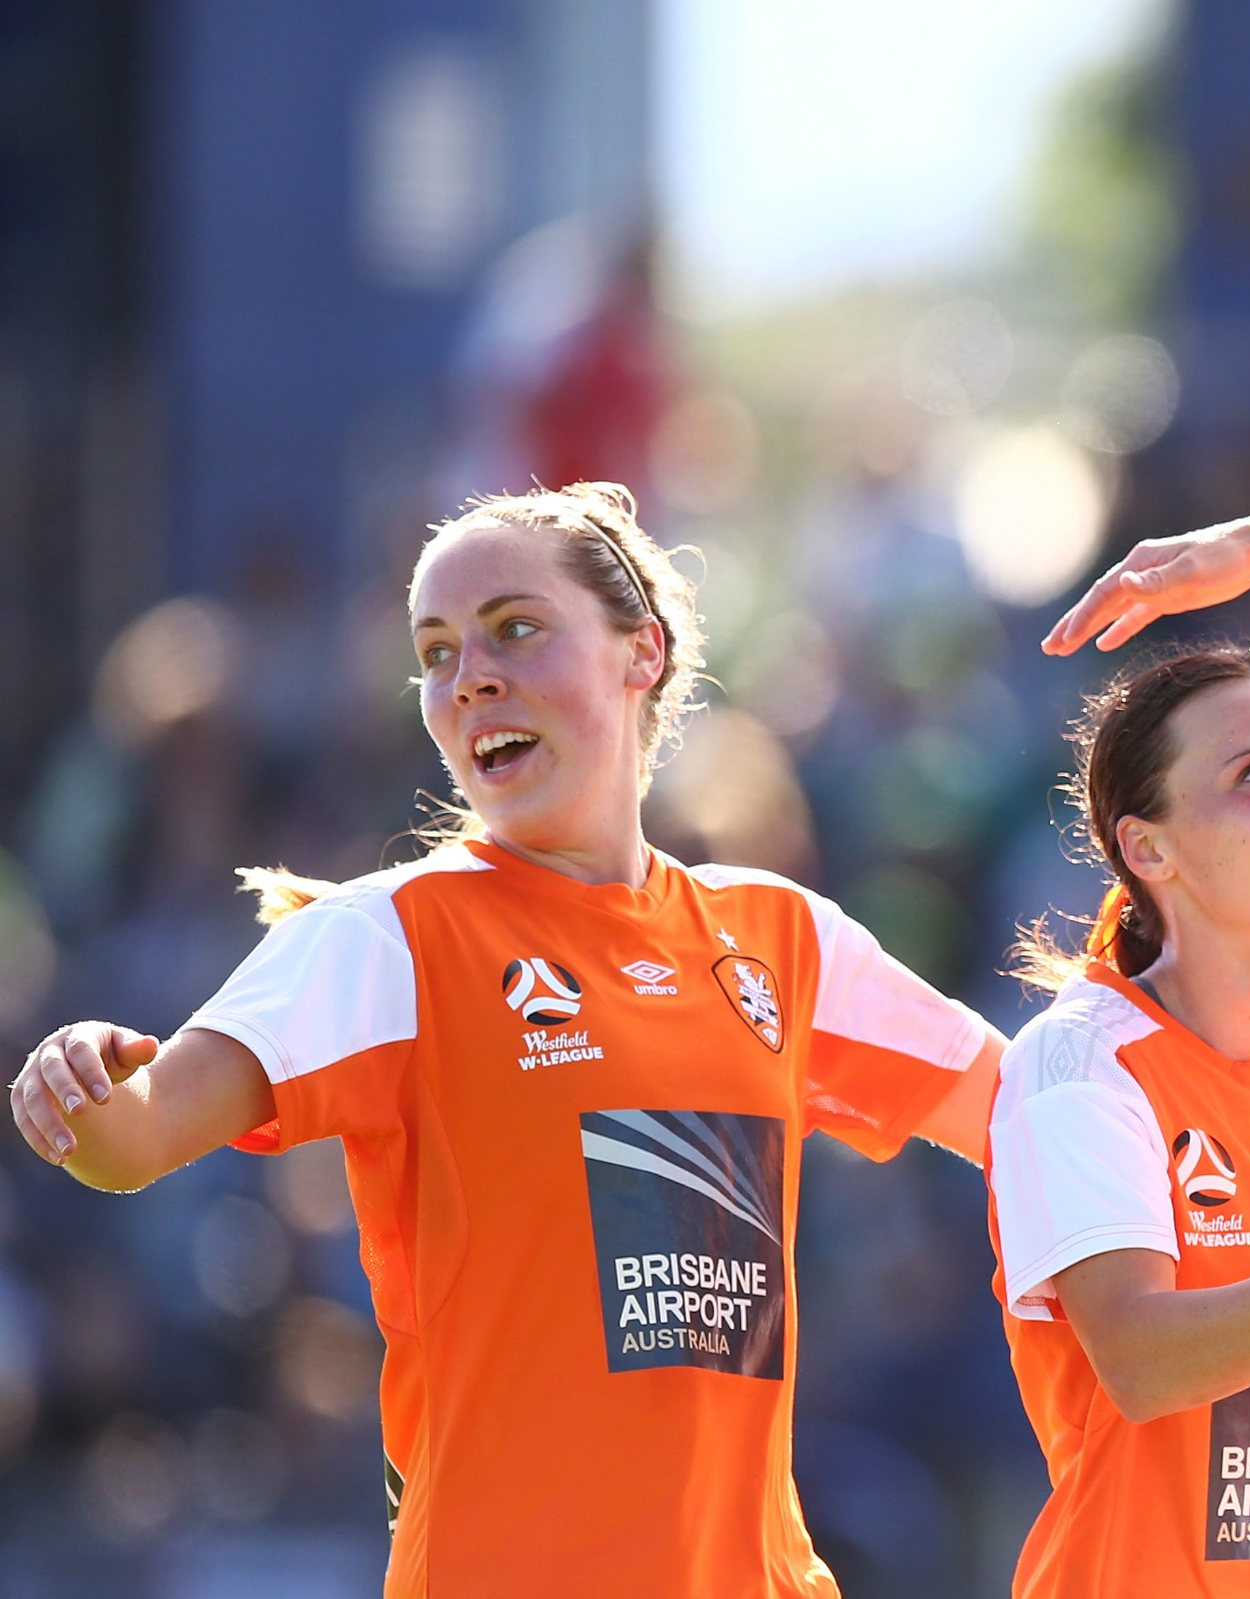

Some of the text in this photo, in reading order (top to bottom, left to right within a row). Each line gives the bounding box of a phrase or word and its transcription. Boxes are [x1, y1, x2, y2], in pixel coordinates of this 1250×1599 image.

[633, 984, 678, 996] umbro
[521, 1029, 590, 1054] Westfield
[1188, 1210, 1243, 1232] Westfield
[614, 1253, 768, 1296] BRISBANE
[619, 1290, 752, 1331] AIRPORT
[622, 1328, 730, 1355] AUSTRALIA
